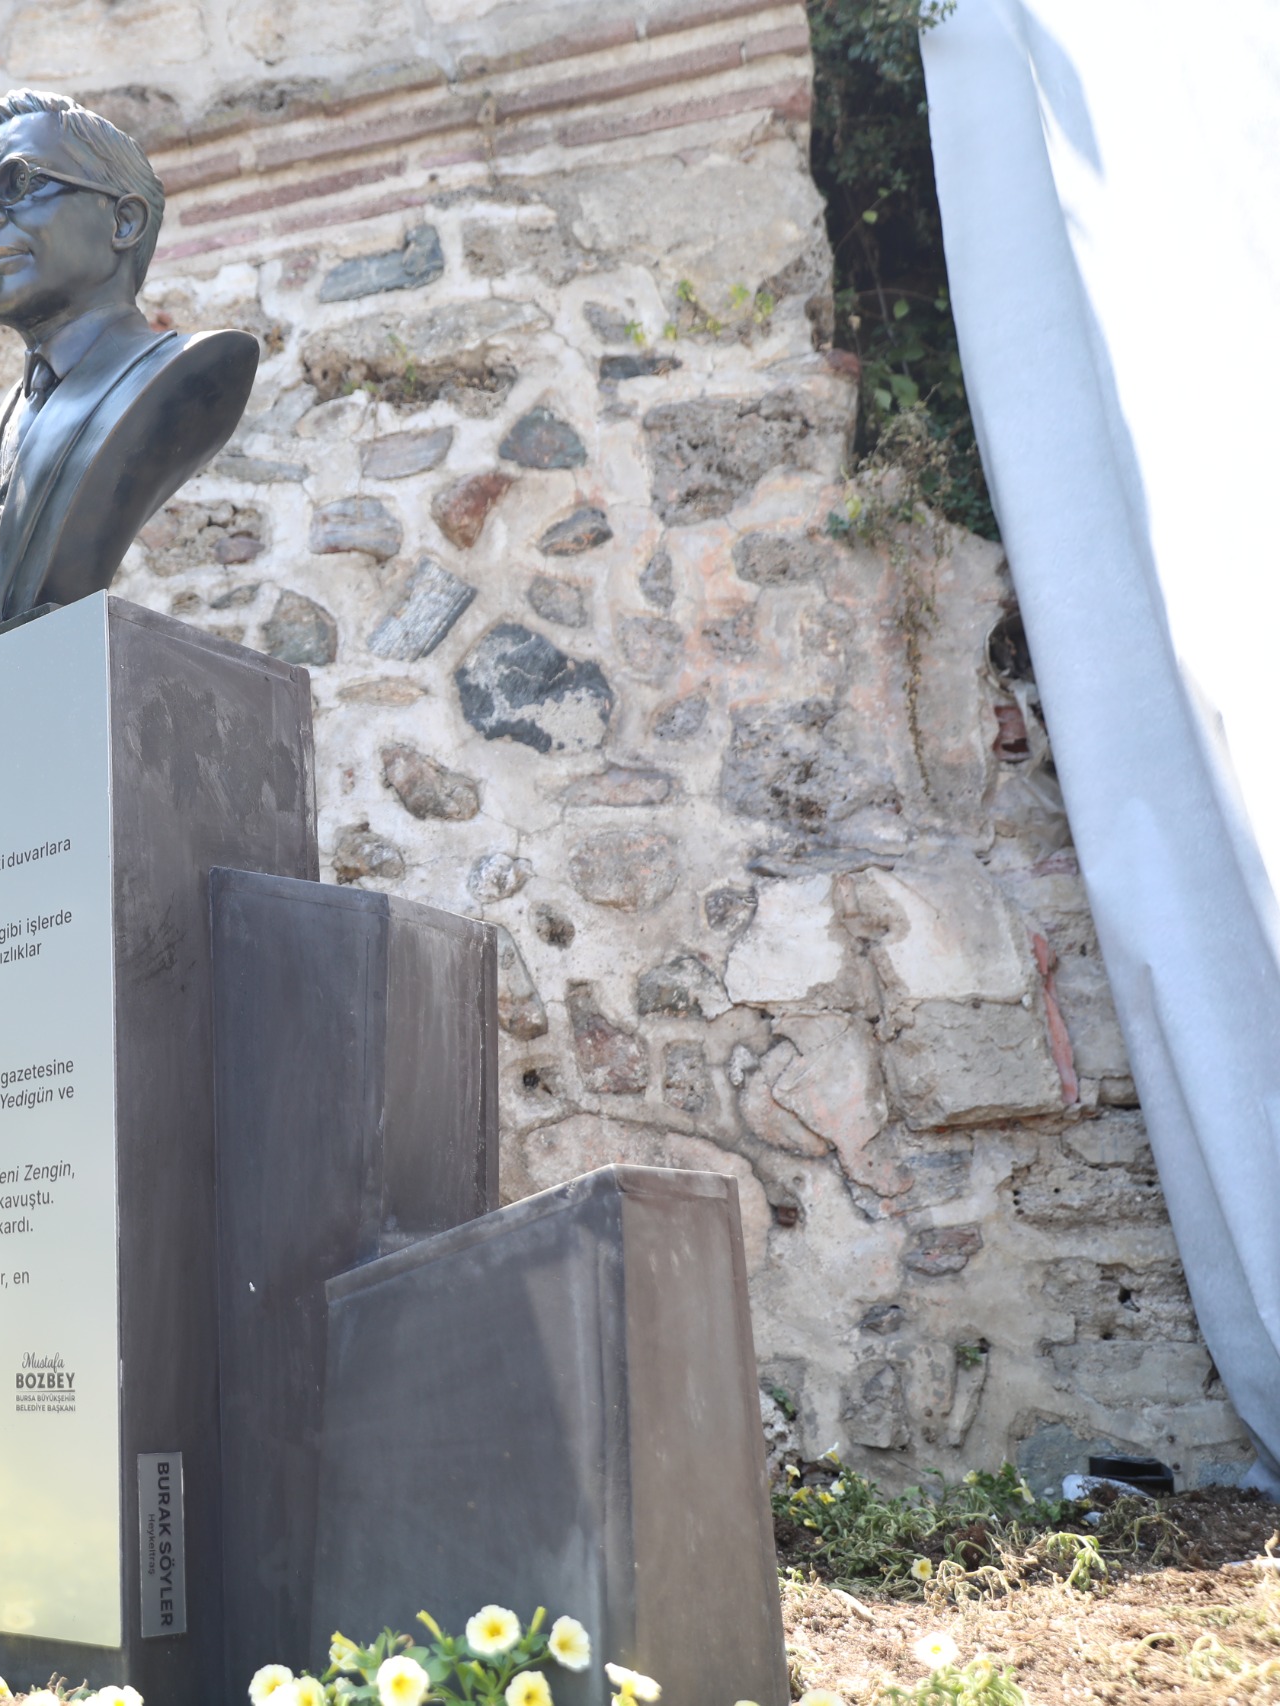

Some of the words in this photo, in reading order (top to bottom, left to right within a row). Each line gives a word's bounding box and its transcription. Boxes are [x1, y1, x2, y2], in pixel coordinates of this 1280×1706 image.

[6, 837, 72, 869] duvarlara
[25, 908, 73, 938] işlerde
[0, 1057, 75, 1090] gazetesine
[0, 1085, 54, 1110] Yedigün
[57, 1084, 75, 1101] ve
[22, 1158, 76, 1183] Zengin,
[12, 1270, 30, 1286] en
[21, 1351, 65, 1374] Mustafa
[15, 1372, 76, 1390] BOZBEY
[15, 1393, 36, 1402] BURSA
[36, 1392, 76, 1404] BÜYÜKŞEHİR
[15, 1402, 47, 1412] BELEDİYE
[47, 1404, 76, 1413] BAŞKANI
[156, 1461, 172, 1537] BURAK
[158, 1541, 175, 1627] SÖYLER
